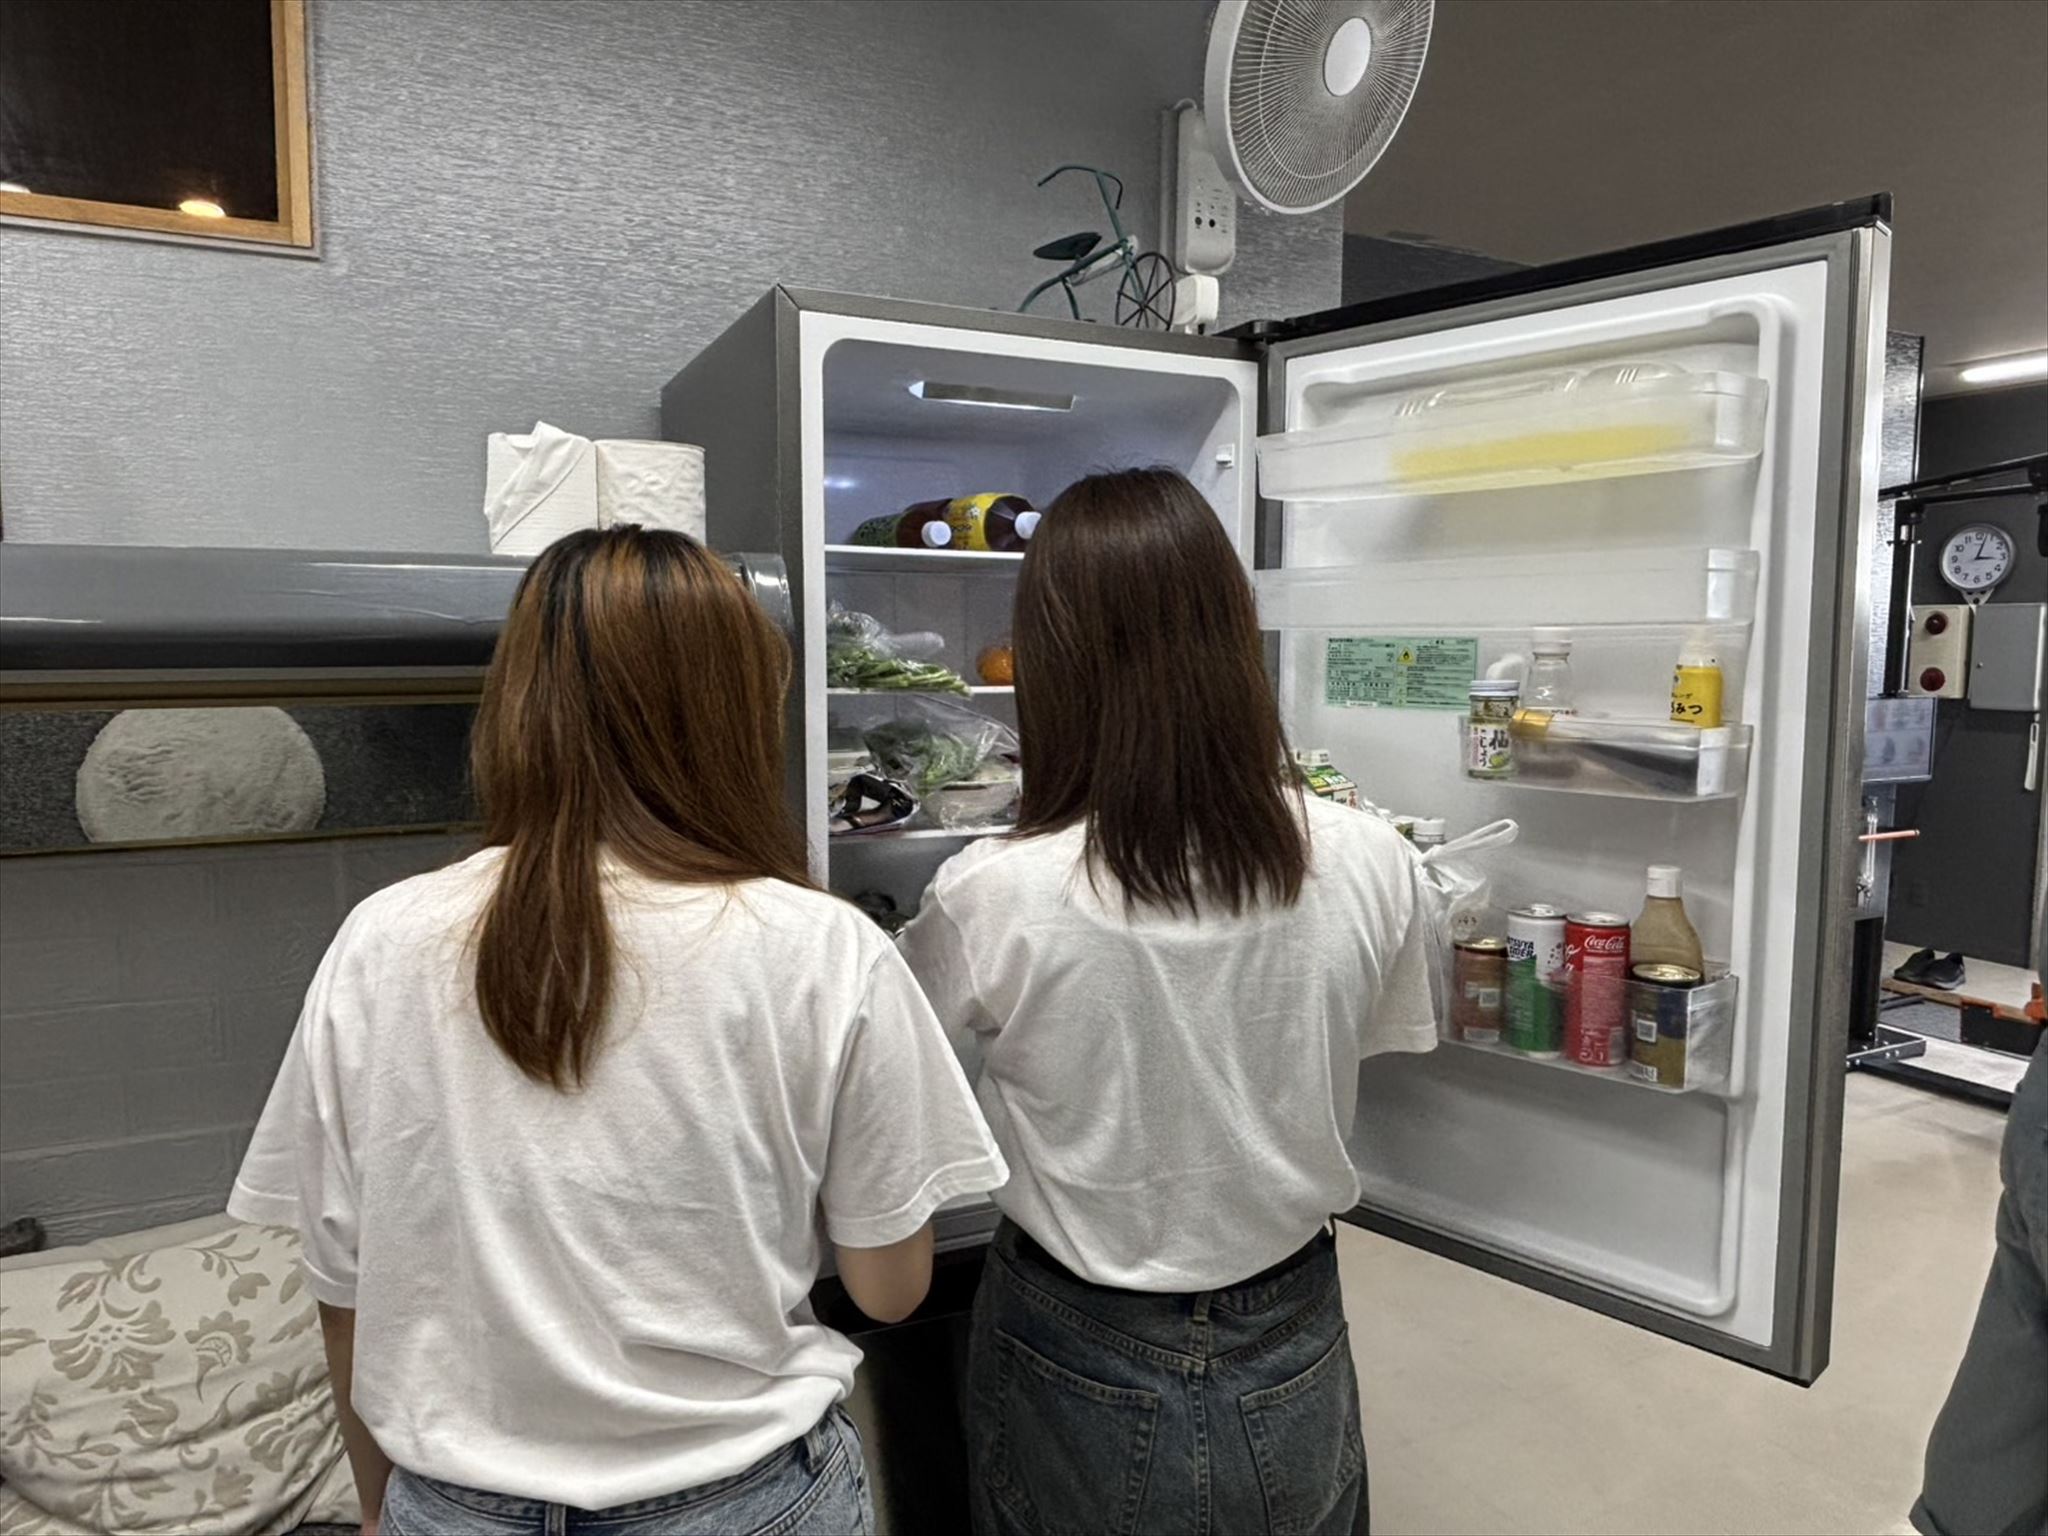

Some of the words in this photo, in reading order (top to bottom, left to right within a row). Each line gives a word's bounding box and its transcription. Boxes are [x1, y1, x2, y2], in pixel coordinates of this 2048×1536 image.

[1964, 535, 1972, 544] 11
[1954, 543, 1965, 553] 10
[1995, 541, 2004, 550] 2
[1951, 554, 1959, 563] 9
[1953, 565, 1961, 574] 8
[1961, 572, 1969, 581] 7
[1972, 574, 1981, 584] 6
[1985, 571, 1993, 581] 5
